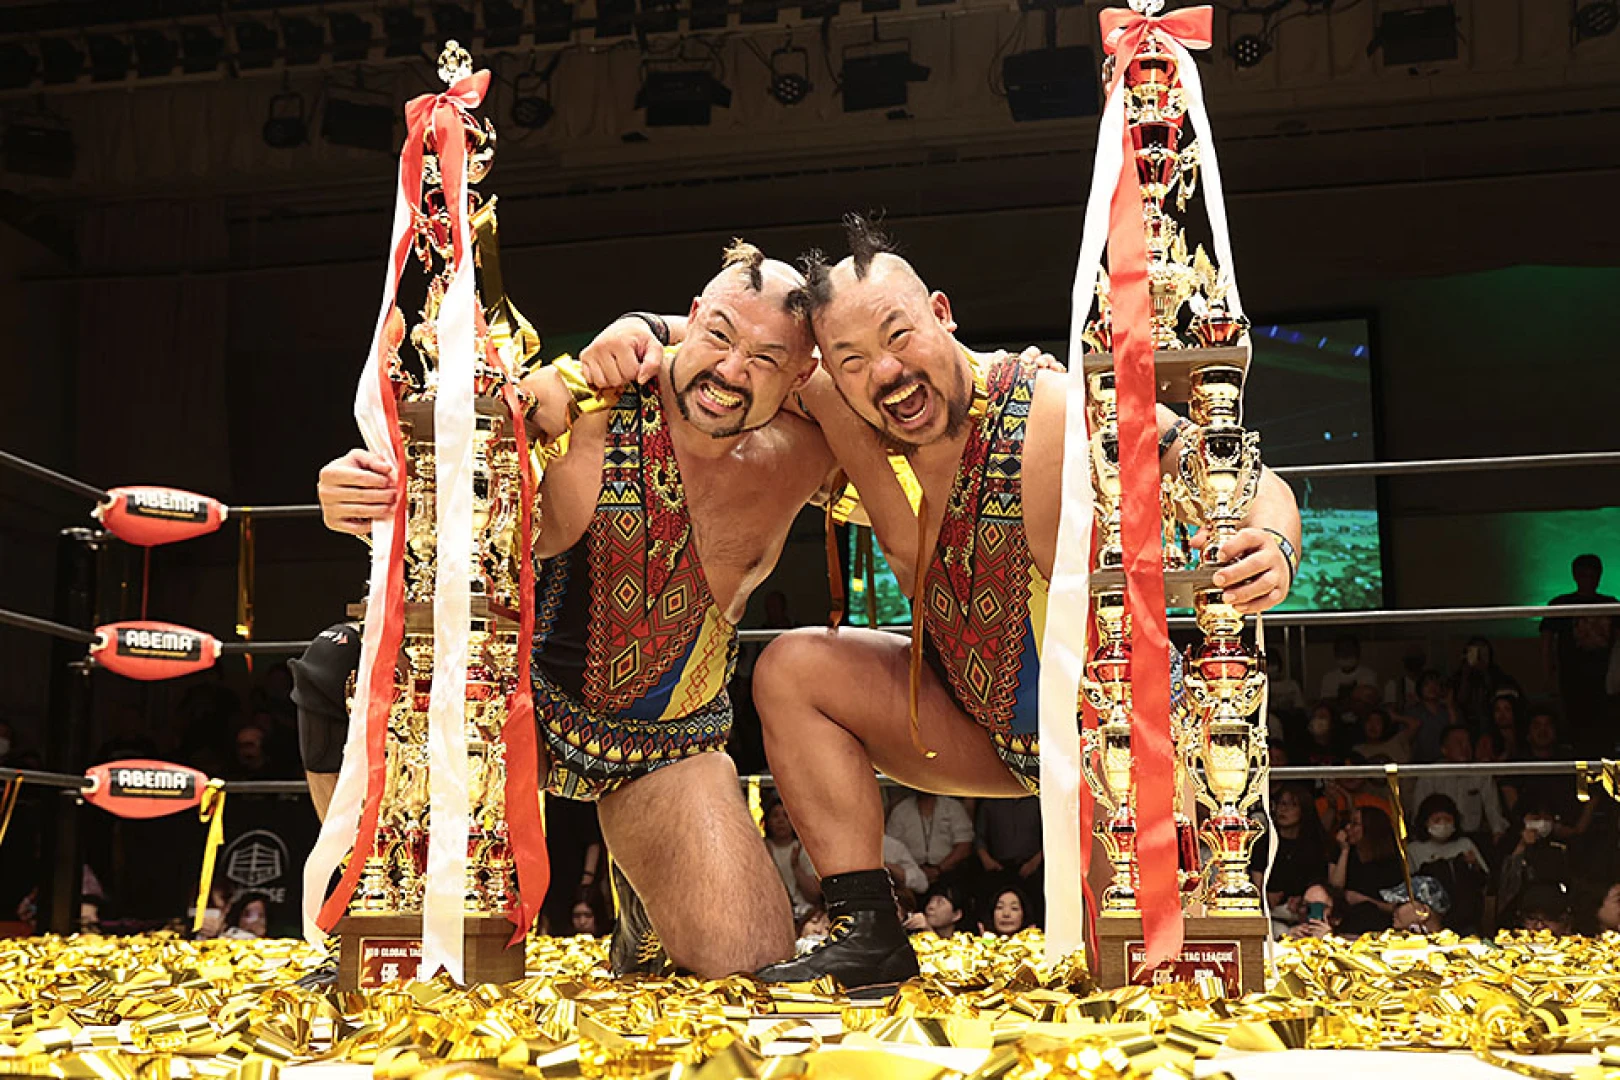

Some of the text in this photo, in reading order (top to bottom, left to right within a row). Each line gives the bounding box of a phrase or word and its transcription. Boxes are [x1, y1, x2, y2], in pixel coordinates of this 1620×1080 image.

[134, 491, 200, 512] ABEMA
[125, 630, 192, 650] ABEMA
[118, 769, 188, 788] ABEMA
[1201, 951, 1233, 962] LEAGUE
